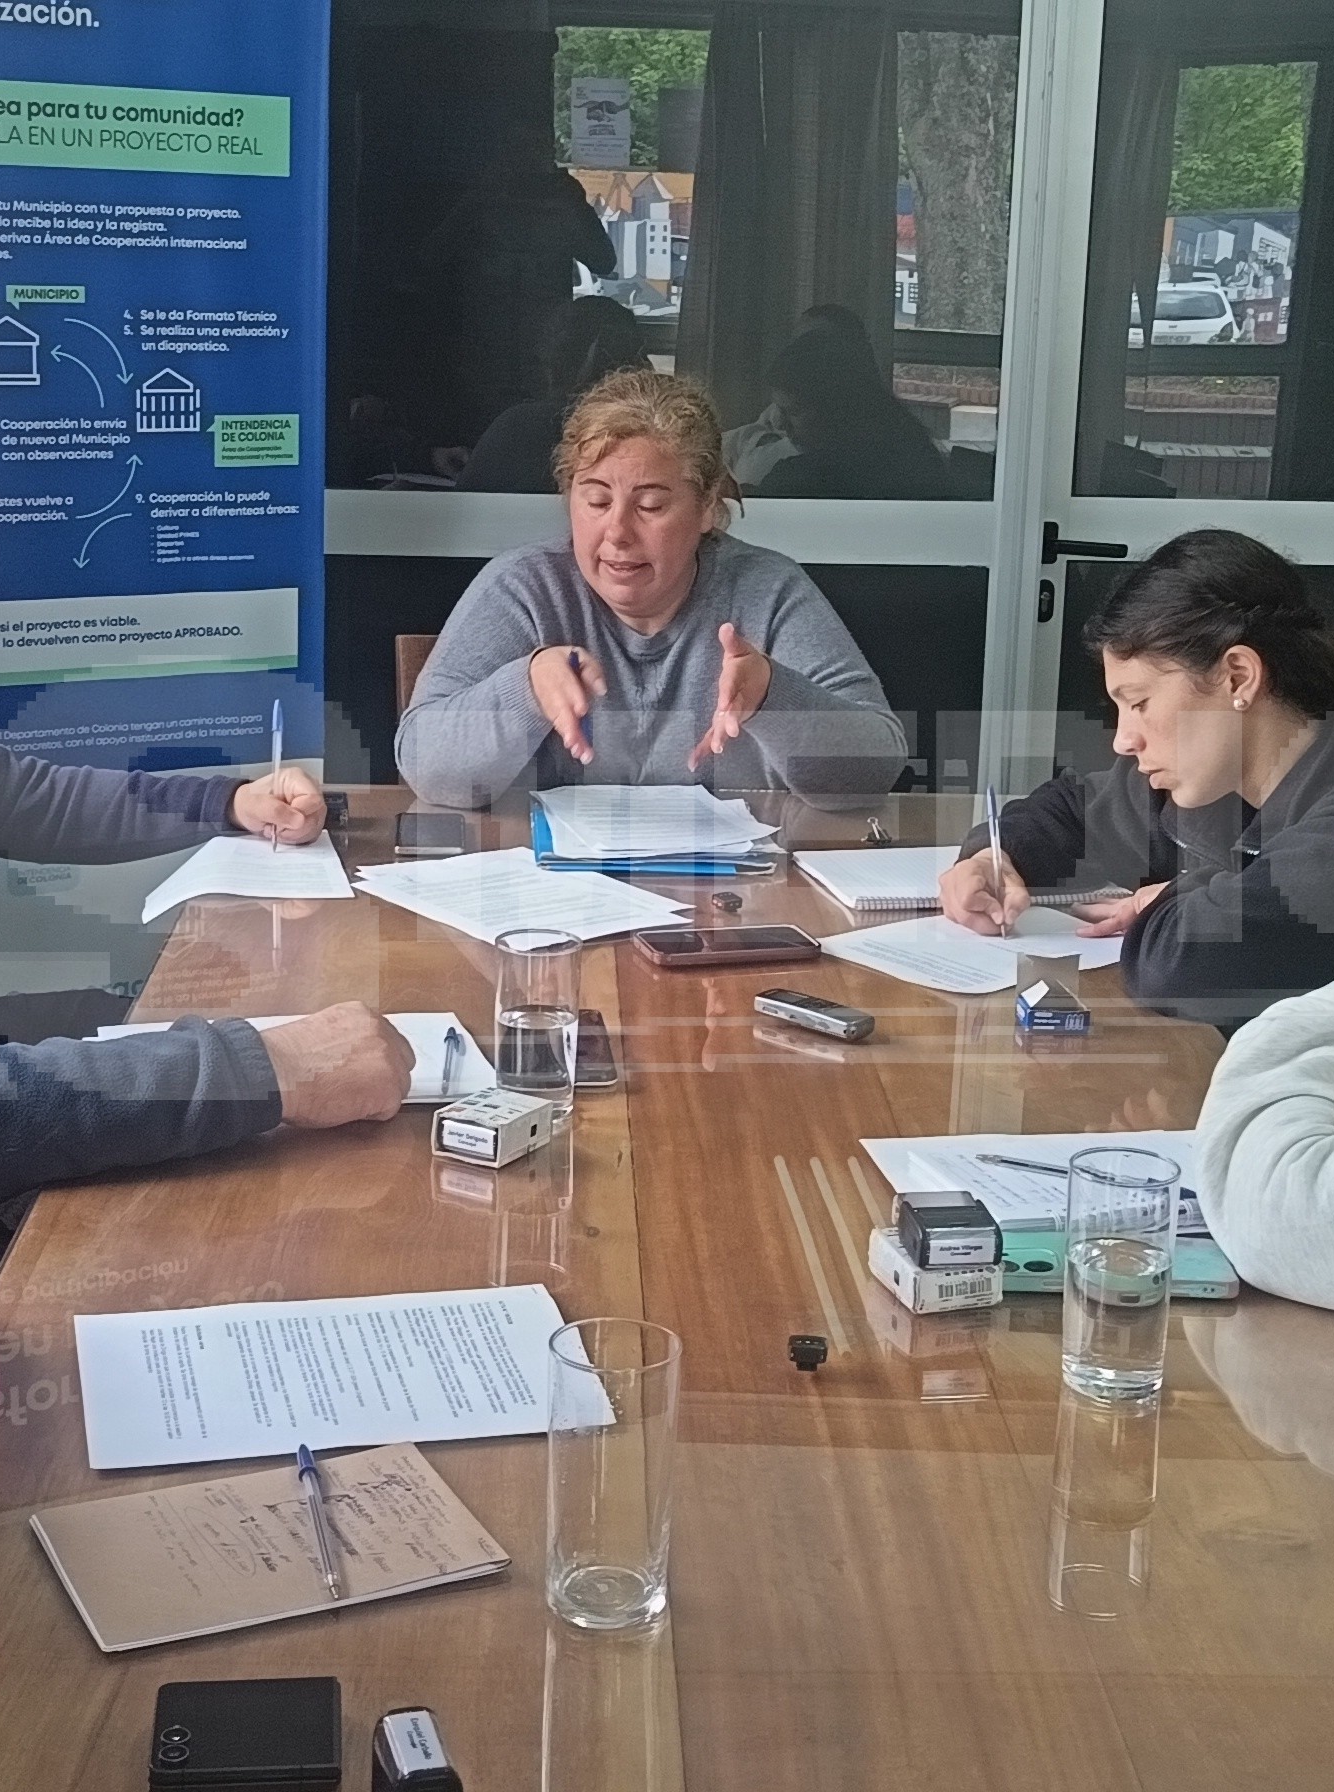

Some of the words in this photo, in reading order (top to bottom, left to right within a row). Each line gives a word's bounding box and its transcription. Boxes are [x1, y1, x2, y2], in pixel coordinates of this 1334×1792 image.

[27, 101, 79, 121] para
[85, 102, 107, 120] tu
[112, 105, 244, 127] comunidad?
[28, 126, 55, 146] EN
[62, 129, 93, 147] UN
[100, 130, 212, 153] PROYECTO
[217, 136, 263, 156] REAL
[13, 200, 72, 214] Municipio
[74, 204, 98, 214] con
[100, 204, 113, 214] tu
[115, 205, 175, 217] propuesta
[176, 207, 185, 217] o
[187, 207, 241, 220] proyecto.
[12, 217, 51, 228] recibe
[53, 217, 65, 229] la
[67, 217, 94, 229] idea
[95, 220, 104, 232] y
[105, 219, 117, 230] la
[120, 220, 167, 233] registra.
[33, 234, 42, 244] a
[44, 231, 72, 245] Área
[74, 234, 90, 245] de
[92, 234, 168, 248] Cooperación
[170, 236, 247, 250] Internacional
[14, 288, 80, 300] MUNICIPIO
[124, 310, 134, 321] 4.
[140, 310, 155, 321] Se
[156, 310, 166, 321] le
[168, 310, 185, 321] da
[186, 311, 235, 322] Formato
[236, 310, 277, 322] Técnico
[124, 326, 134, 336] 5.
[140, 325, 155, 336] Se
[156, 325, 195, 337] realiza
[197, 327, 220, 337] una
[221, 326, 280, 338] evaluación
[280, 329, 289, 339] y
[141, 342, 157, 351] un
[0, 418, 79, 432] Cooperación
[80, 418, 92, 429] lo
[93, 418, 127, 429] envía
[221, 420, 291, 430] INTENDENCIA
[1, 435, 18, 445] de
[20, 435, 57, 445] nuevo
[58, 434, 69, 444] al
[71, 433, 131, 446] Municipio
[221, 432, 236, 442] DE
[238, 431, 285, 442] COLONIA
[1, 452, 25, 461] con
[27, 448, 114, 461] observaciones
[25, 495, 63, 506] vuelve
[65, 497, 74, 505] a
[135, 493, 145, 503] 9.
[149, 491, 222, 504] Cooperación
[225, 491, 235, 502] lo
[237, 491, 270, 503] puede
[151, 507, 191, 518] derivar
[191, 509, 199, 517] a
[0, 621, 9, 632] si
[13, 621, 23, 631] el
[27, 620, 81, 633] proyecto
[84, 620, 97, 628] es
[100, 616, 140, 626] viable.
[3, 638, 14, 647] lo
[17, 634, 79, 647] devuelven
[82, 634, 116, 643] como
[119, 630, 172, 643] proyecto
[174, 626, 243, 638] APROBADO.
[4, 727, 76, 740] Departamento
[77, 726, 89, 734] de
[92, 722, 129, 732] Colonia
[131, 721, 165, 732] tengan
[179, 716, 214, 727] camino
[215, 715, 239, 725] claro
[241, 714, 262, 725] para
[65, 740, 84, 748] con
[85, 737, 94, 745] el
[96, 736, 127, 746] apoyo
[129, 731, 184, 742] institucional
[185, 730, 197, 738] de
[199, 728, 208, 737] la
[210, 726, 264, 736] Intendencia
